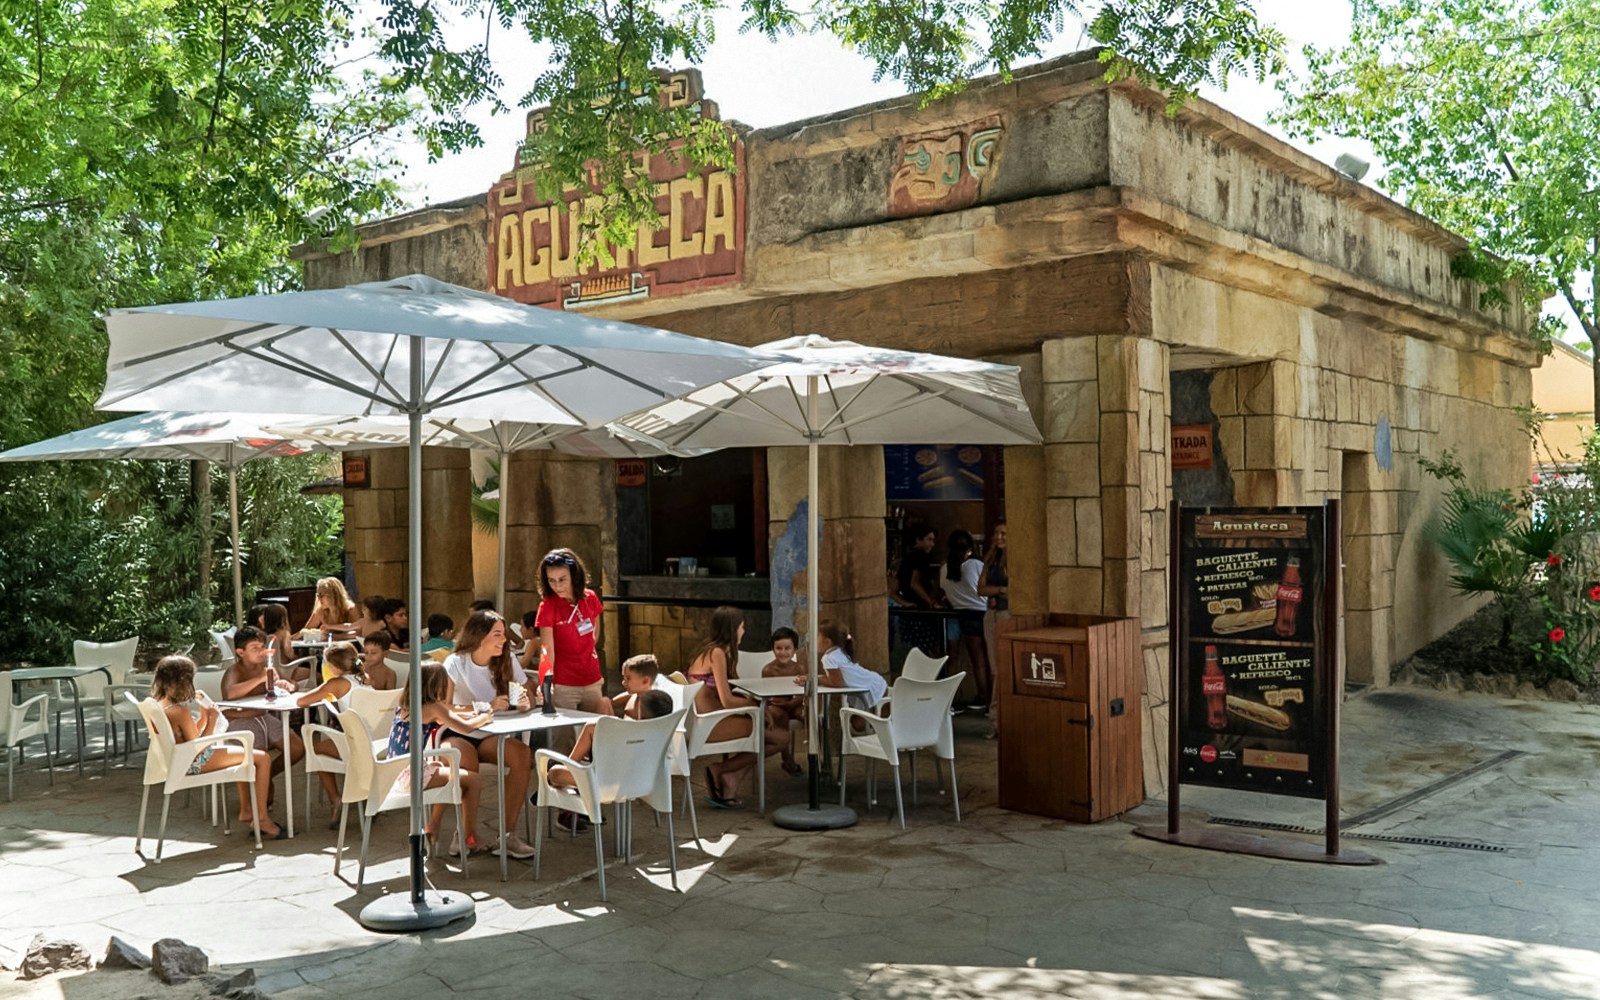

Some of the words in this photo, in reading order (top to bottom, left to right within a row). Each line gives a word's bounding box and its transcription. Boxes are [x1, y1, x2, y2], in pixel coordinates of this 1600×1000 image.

[1196, 552, 1259, 566] BAGUETTE
[1216, 558, 1277, 572] CALIENTE
[1204, 570, 1254, 582] REFRESCO
[1207, 582, 1247, 592] PATATAS
[1222, 652, 1286, 665] BAGUETTE
[1248, 659, 1311, 671] CALIENTE
[1239, 669, 1291, 680] REFRESCO
